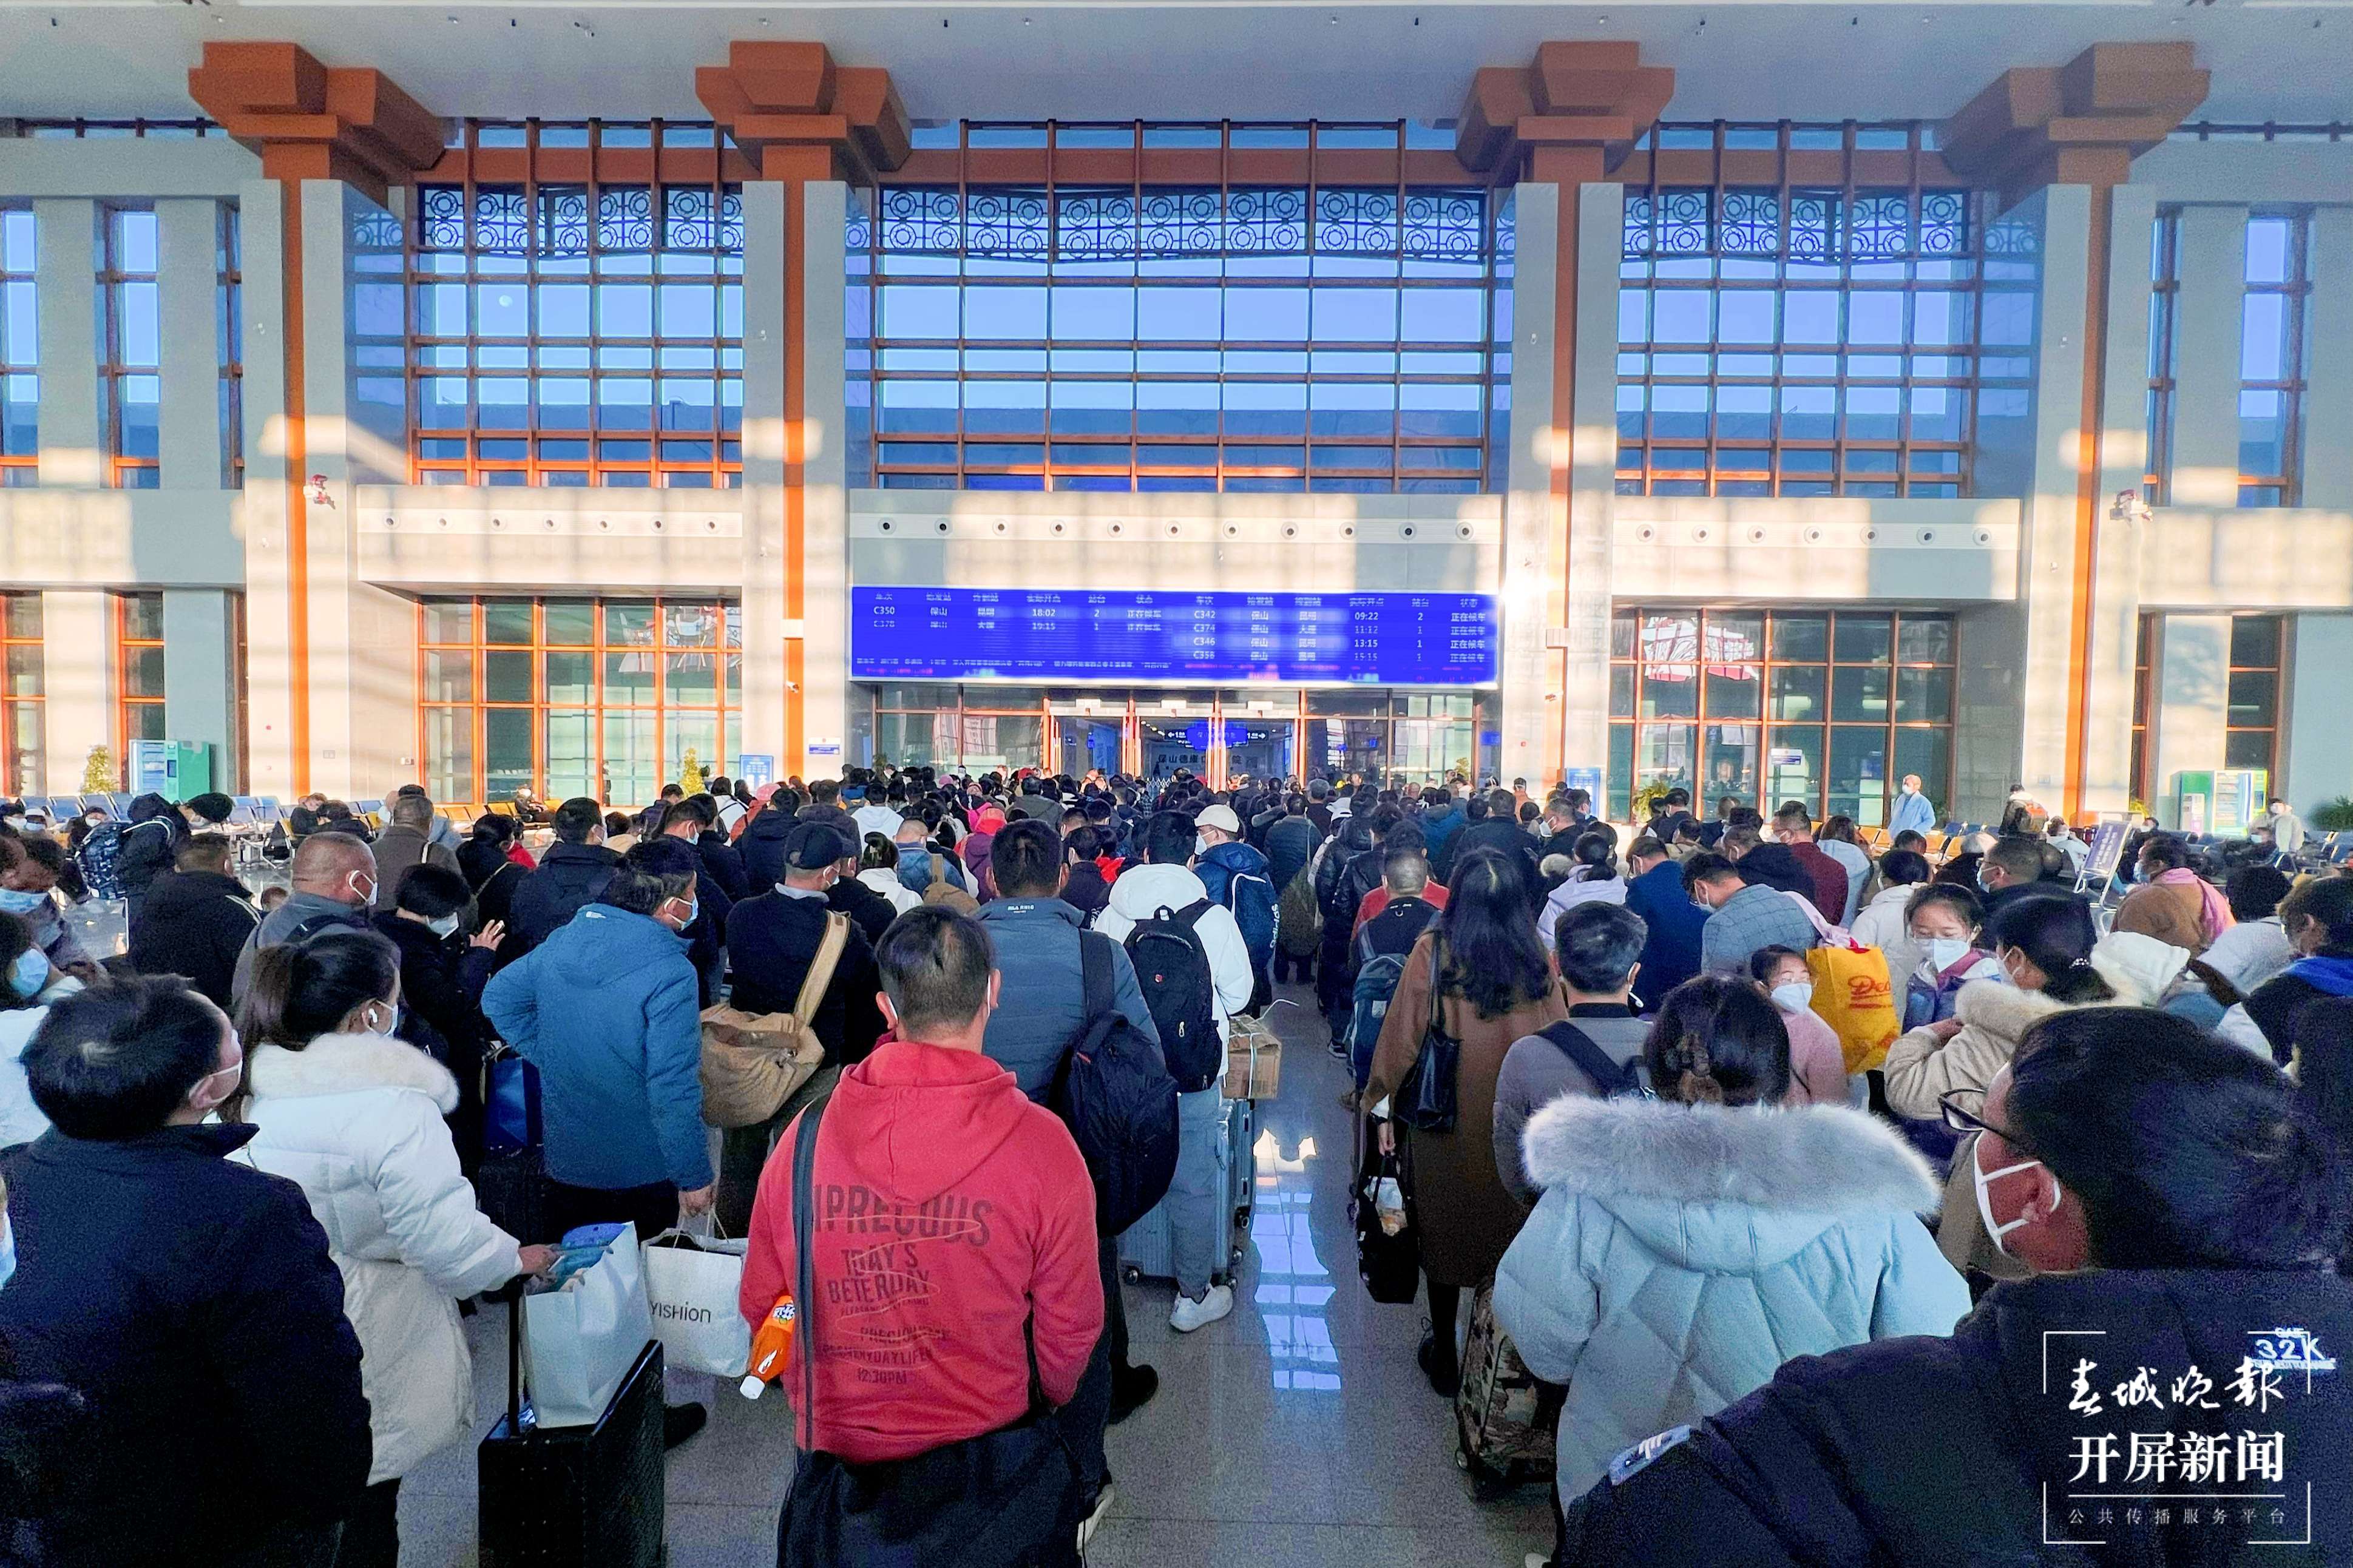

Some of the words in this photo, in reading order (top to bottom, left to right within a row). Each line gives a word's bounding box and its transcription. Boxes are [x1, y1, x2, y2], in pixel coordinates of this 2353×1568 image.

[873, 606, 895, 615] C350
[1032, 609, 1056, 617] 18:02
[1194, 610, 1215, 619] C342
[1354, 612, 1379, 620] 09:22
[1417, 612, 1424, 621] 2
[1451, 612, 1486, 622] 正在候车
[1417, 626, 1423, 635] 1
[1193, 637, 1215, 646] C346
[1354, 639, 1378, 648] 13:15
[1417, 640, 1422, 648] 1
[1450, 640, 1485, 649] 正在候车
